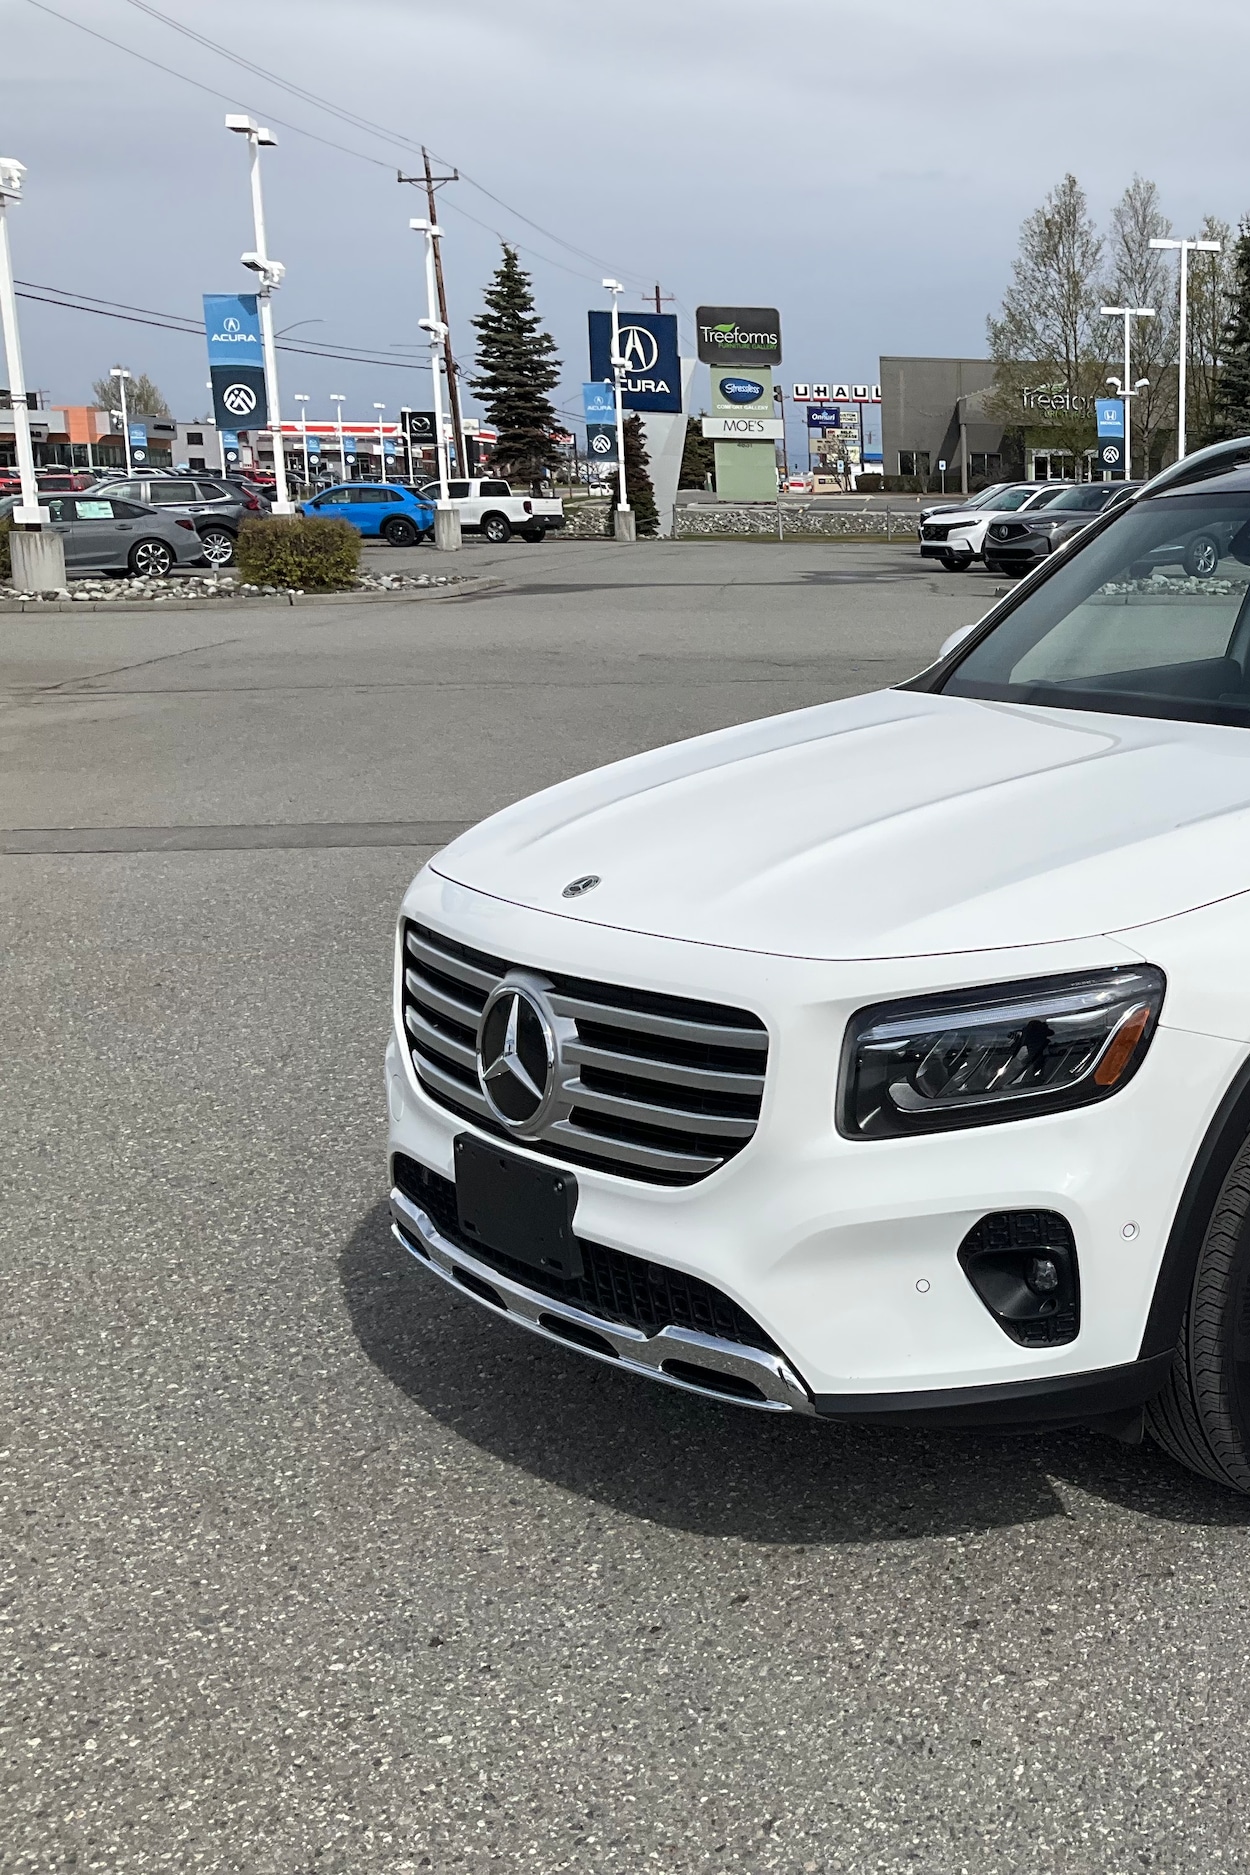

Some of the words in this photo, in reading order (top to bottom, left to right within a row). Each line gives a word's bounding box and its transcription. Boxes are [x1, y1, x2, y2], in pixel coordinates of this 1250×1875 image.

[211, 333, 257, 342] ACURA
[700, 326, 778, 345] Treeforms
[725, 383, 761, 394] Stressless
[723, 420, 764, 432] MOE'S
